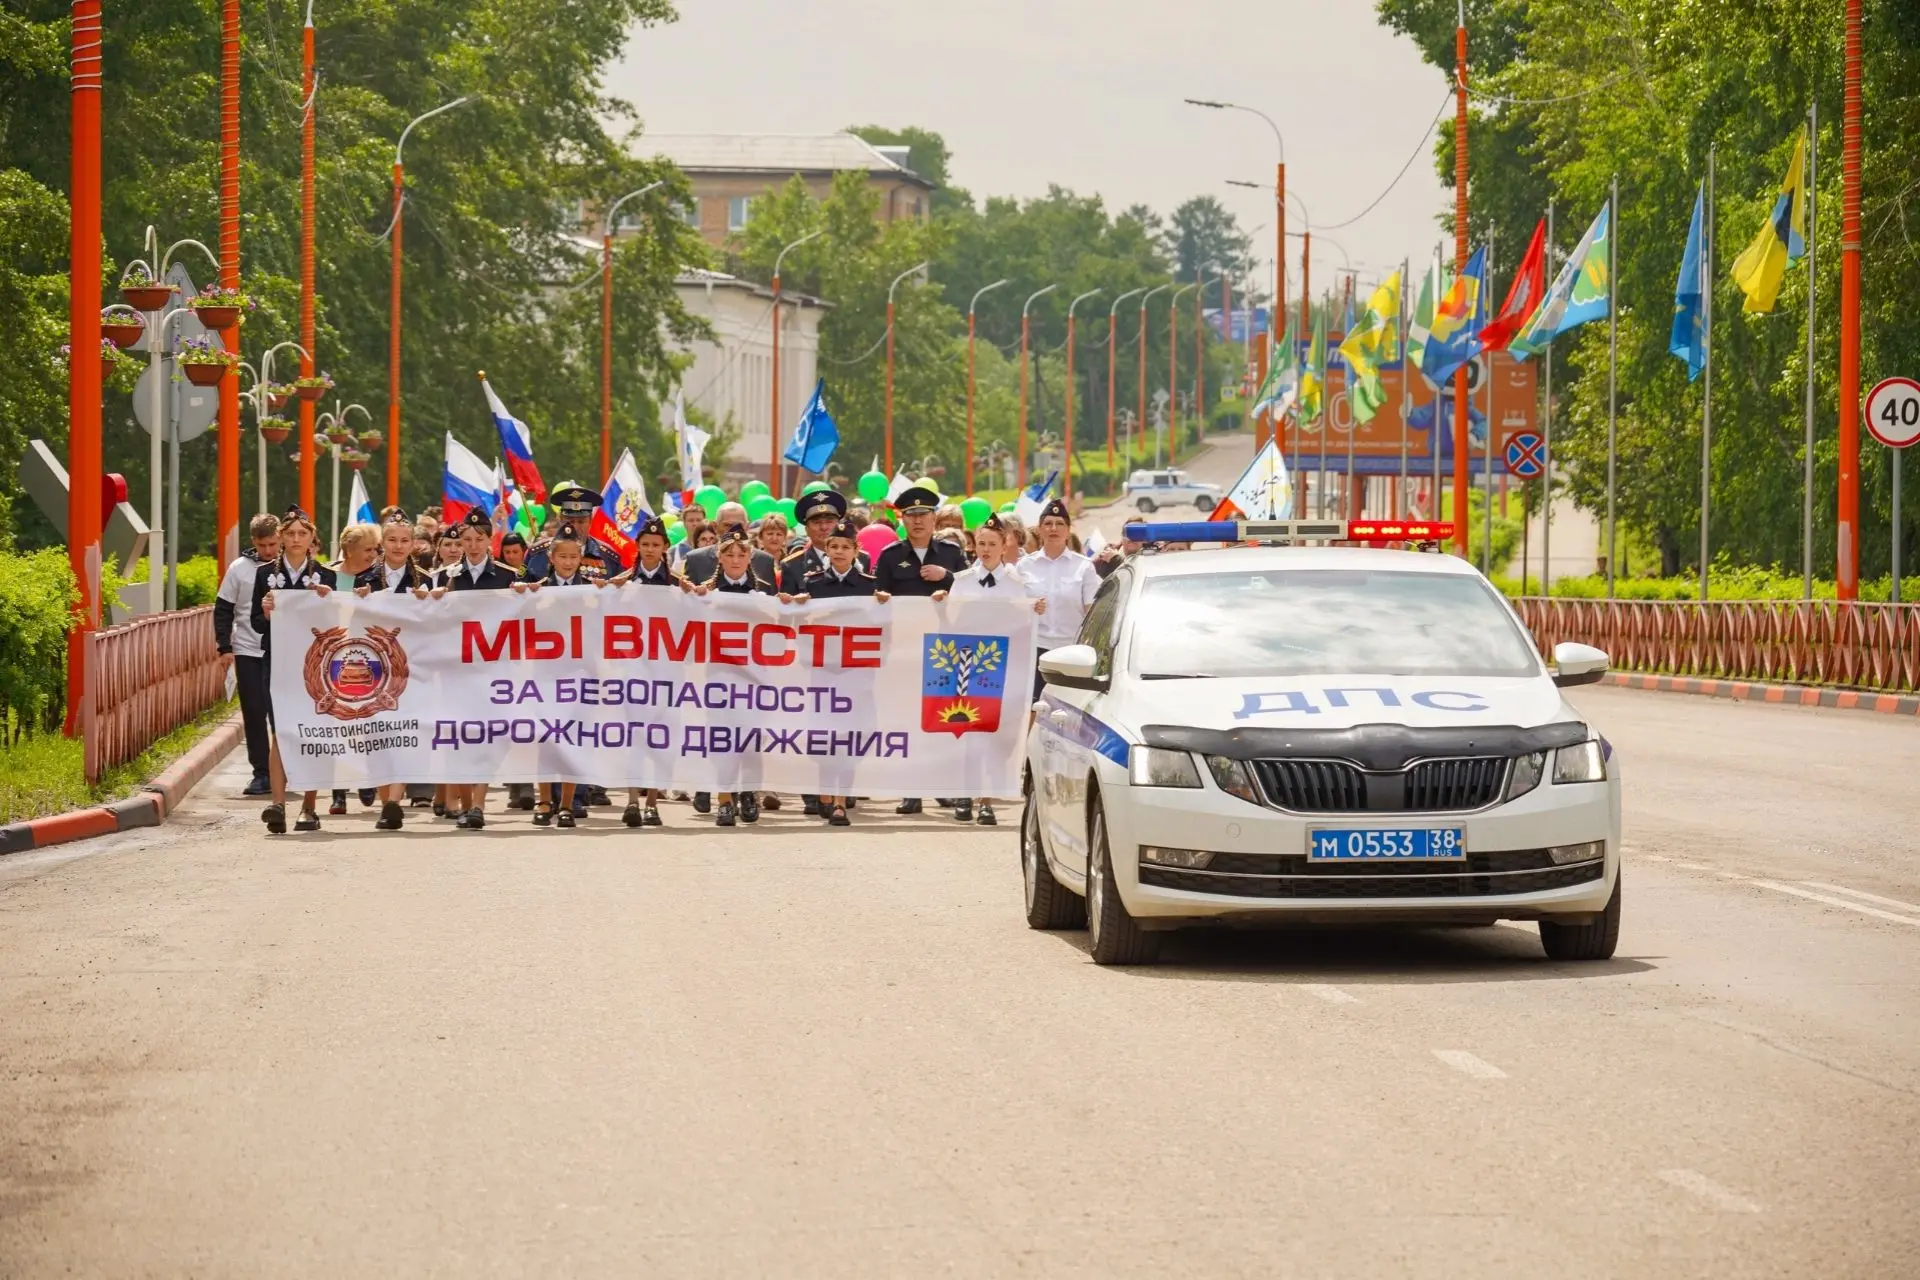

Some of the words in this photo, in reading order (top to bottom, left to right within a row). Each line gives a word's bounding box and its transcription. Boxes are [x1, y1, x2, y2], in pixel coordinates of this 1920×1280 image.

[1881, 397, 1919, 426] 40
[461, 615, 583, 664] МЫ
[603, 615, 883, 668] ВМЕСТЕ
[489, 679, 544, 705] ЗА
[555, 678, 853, 713] БЕЗОПАСНОСТЬ
[1233, 688, 1490, 720] ДПС
[297, 719, 419, 738] Госавтоинспекция
[432, 718, 670, 750] ДОРОЖНОГО
[681, 725, 909, 758] ДВИЖЕНИЯ
[301, 743, 346, 757] города
[348, 735, 419, 755] Черемхово
[1347, 831, 1414, 857] 0553
[1430, 829, 1456, 849] 38
[1433, 849, 1452, 857] RUS
